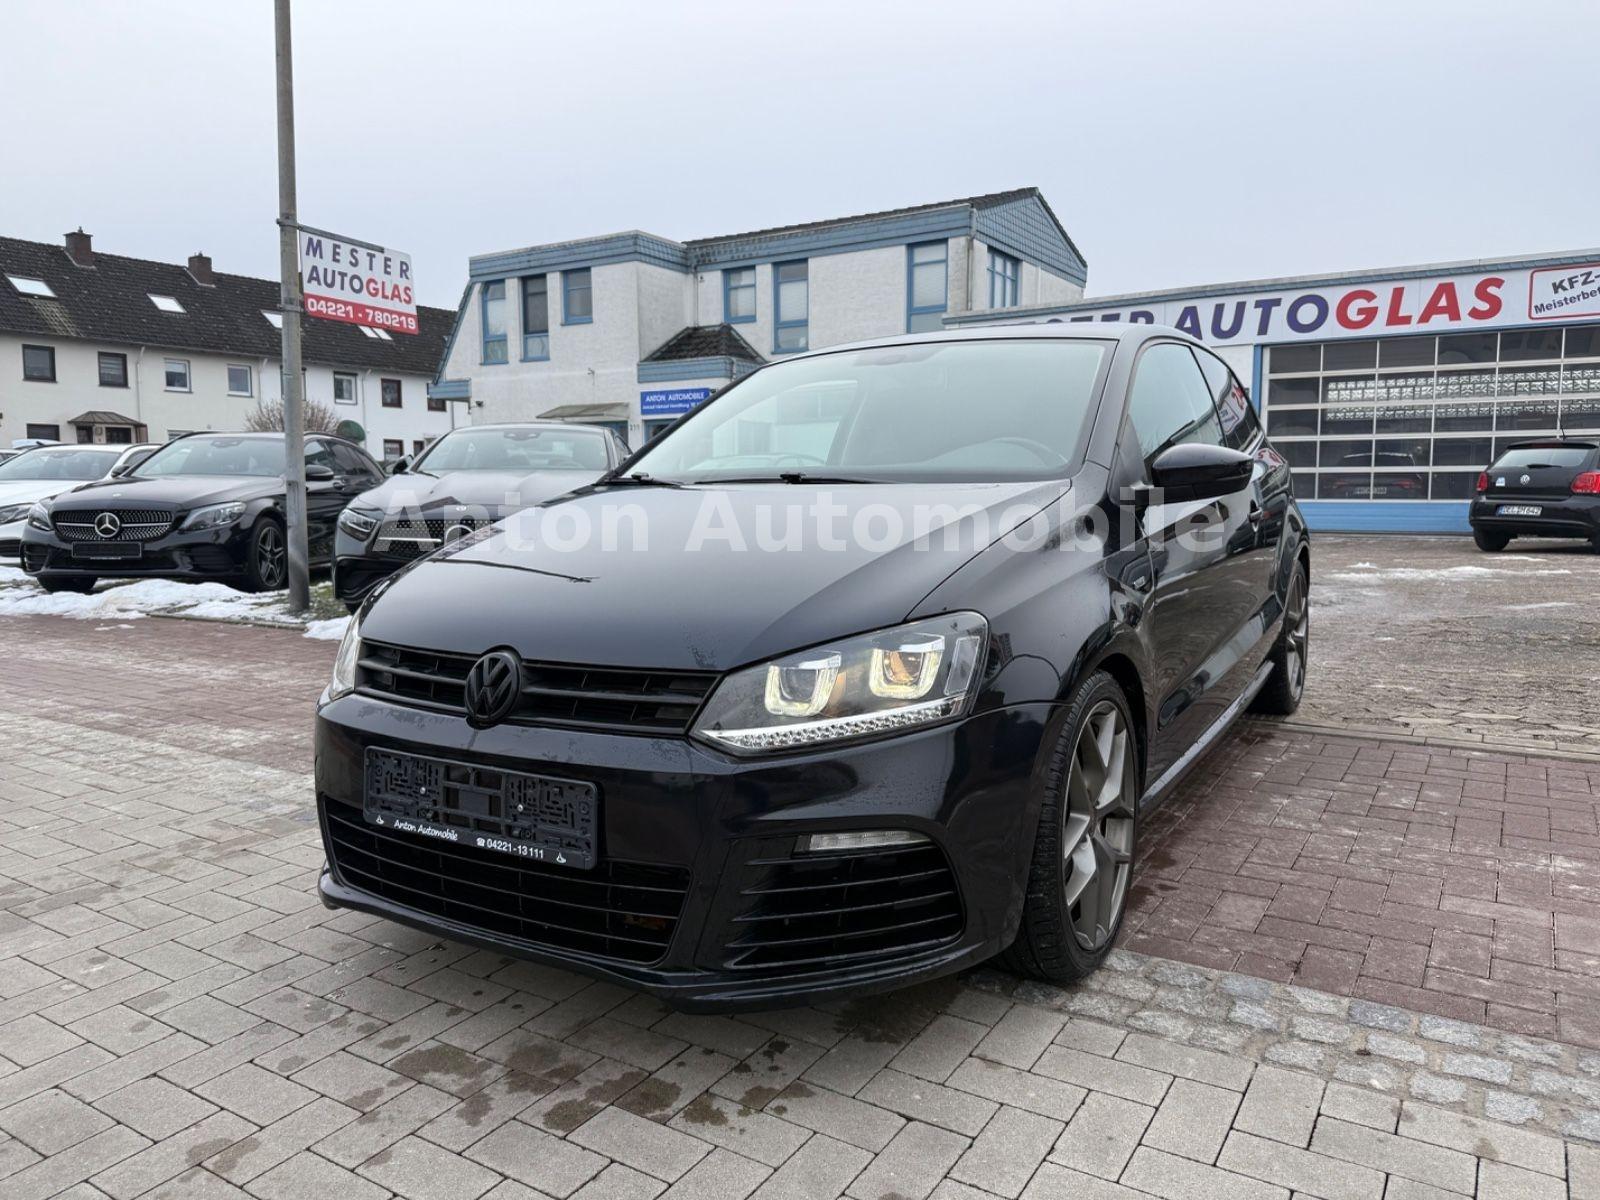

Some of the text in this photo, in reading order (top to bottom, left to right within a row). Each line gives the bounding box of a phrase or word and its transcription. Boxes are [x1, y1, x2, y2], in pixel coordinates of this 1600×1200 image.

[305, 236, 410, 280] MESTER
[306, 265, 412, 305] AUTOGLAS
[1551, 270, 1600, 295] KFZ-
[306, 298, 354, 318] 04221
[365, 308, 416, 330] 780219
[1174, 277, 1506, 341] AUTOGLAS
[645, 391, 706, 402] ANTON AUTOMOBILE
[393, 819, 417, 832] Anton
[417, 825, 459, 842] Automobile
